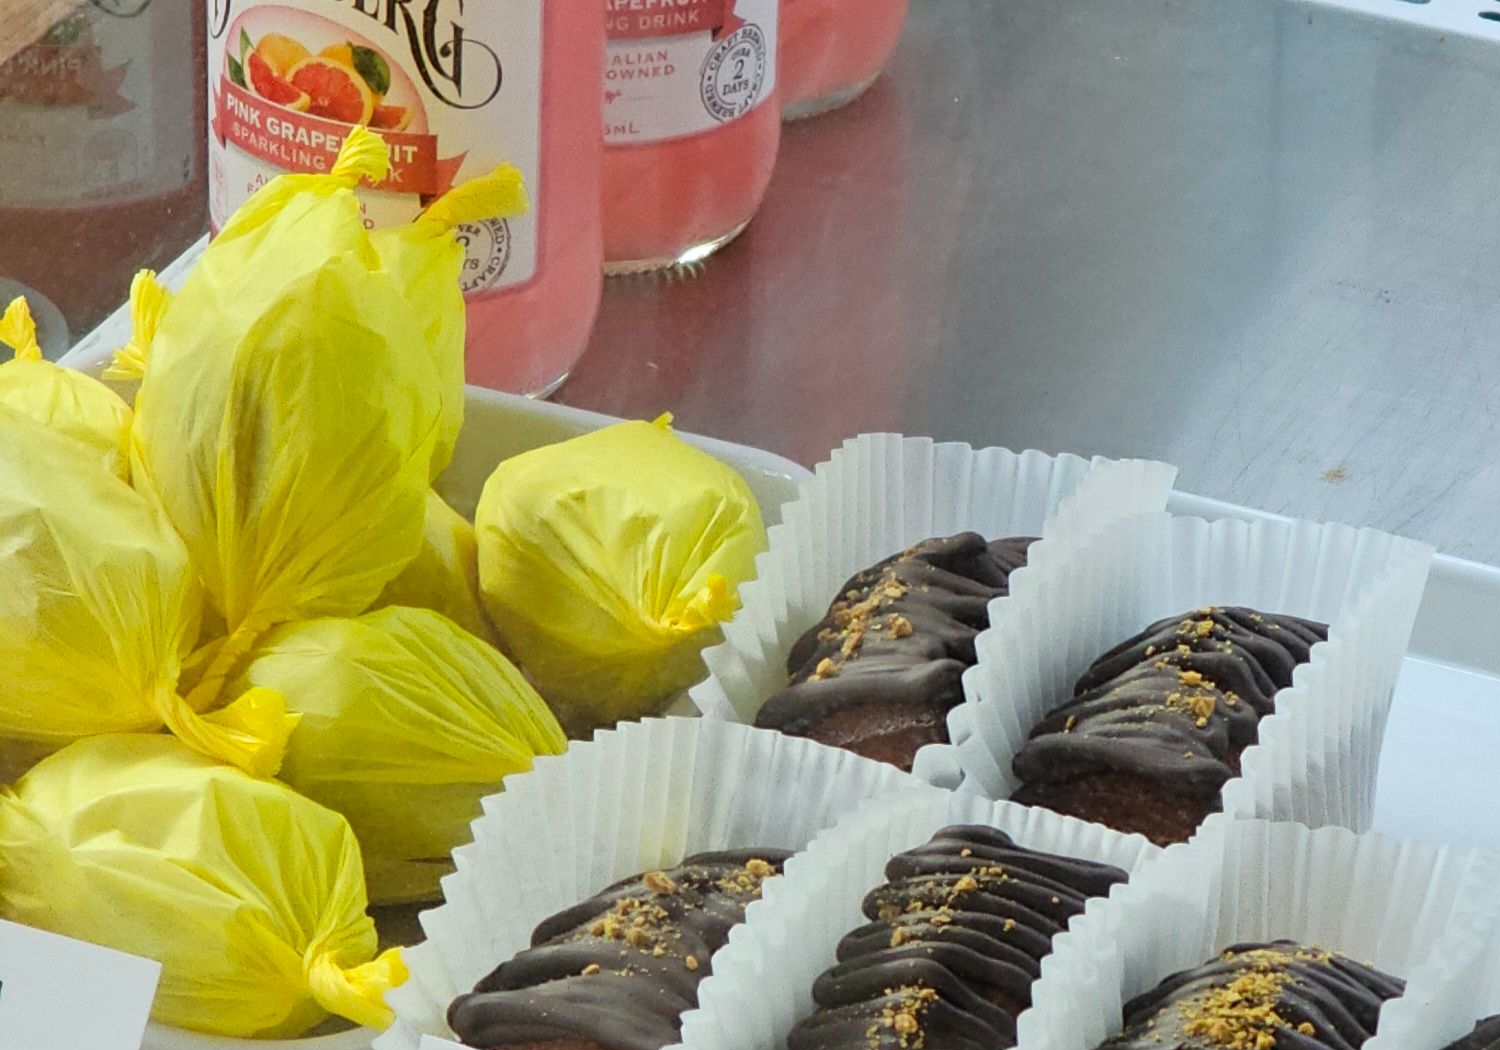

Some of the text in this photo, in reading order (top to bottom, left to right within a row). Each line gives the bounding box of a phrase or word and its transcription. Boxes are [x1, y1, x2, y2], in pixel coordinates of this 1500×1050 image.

[639, 9, 700, 30] DRINK
[612, 50, 669, 67] ALIAN
[732, 58, 746, 80] 2
[722, 79, 750, 96] DAYS
[225, 92, 418, 164] PINK GRAPEIT
[231, 121, 326, 171] SPARKLING
